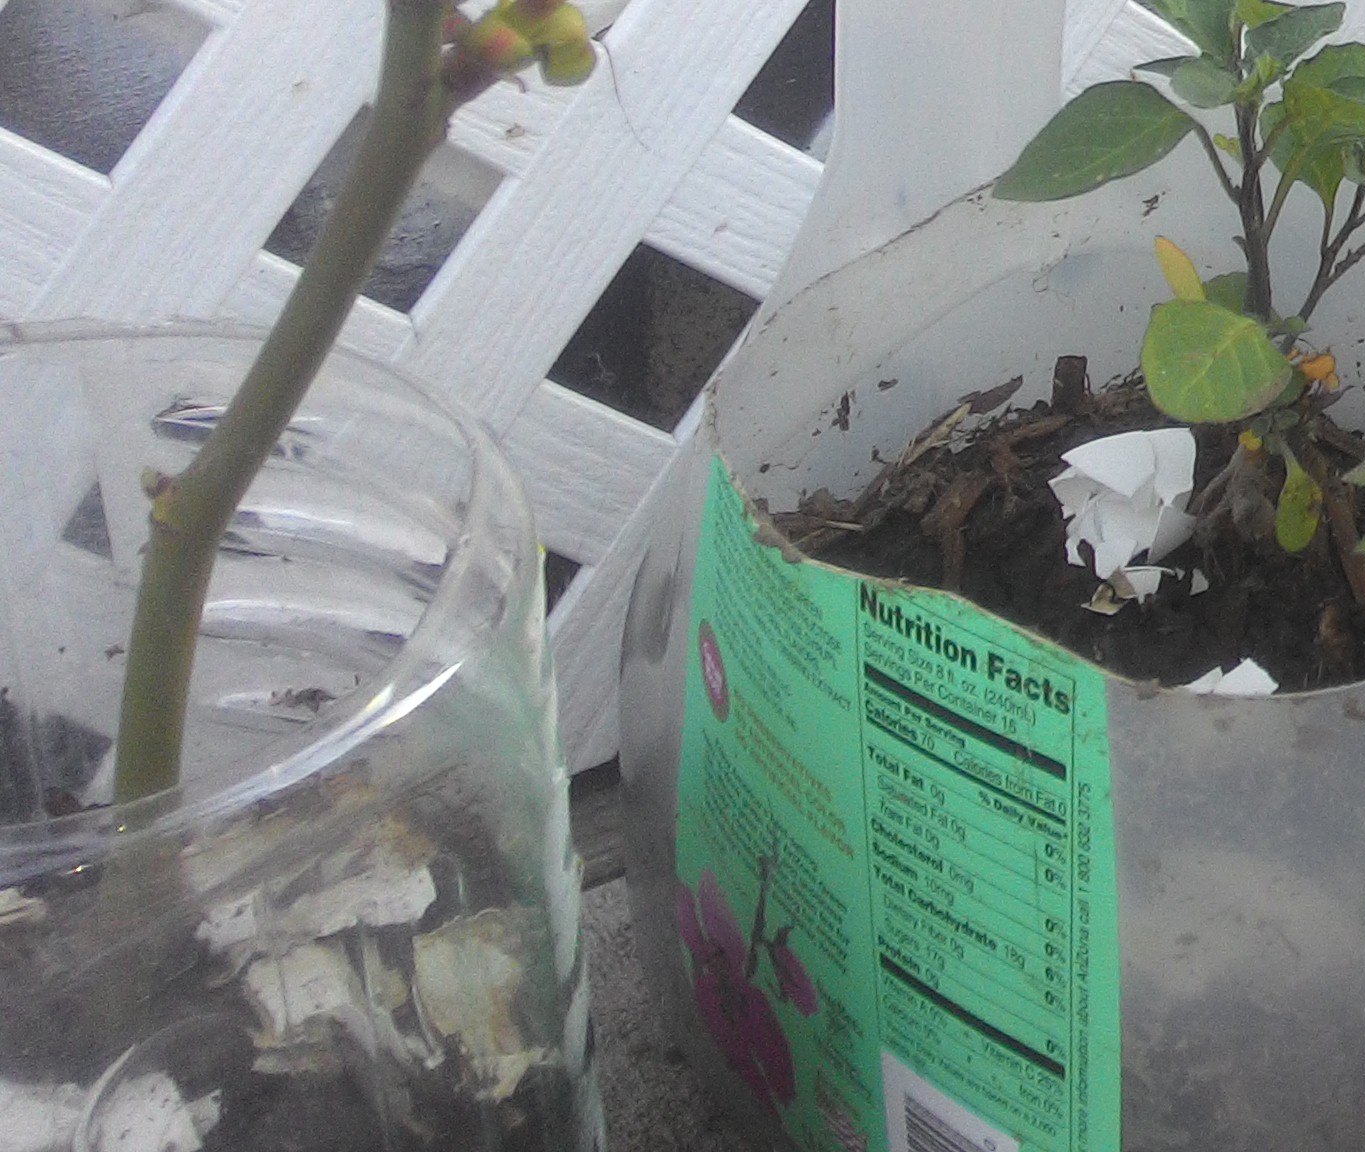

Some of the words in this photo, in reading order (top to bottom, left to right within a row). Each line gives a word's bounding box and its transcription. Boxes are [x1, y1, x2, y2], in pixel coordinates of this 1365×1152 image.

[859, 583, 976, 670] Nutrition
[987, 651, 1069, 714] Facts
[862, 621, 905, 662] Serving
[907, 647, 933, 673] Size
[935, 663, 944, 679] 8
[863, 641, 911, 681] Servings
[913, 670, 935, 693] Per
[937, 683, 996, 723] Container
[1001, 715, 1016, 734] 16
[863, 681, 901, 711] Amount
[903, 705, 922, 723] Per
[924, 716, 965, 748] Serving
[864, 698, 917, 741] Calories
[920, 731, 935, 751] 70
[953, 750, 1002, 786] Calories
[1004, 774, 1033, 800] from
[1035, 789, 1055, 812] Fat
[1057, 801, 1066, 817] 0
[866, 744, 899, 775] Total
[902, 767, 923, 790] Fat
[929, 783, 945, 806] 0g
[1044, 842, 1067, 866] 0%
[904, 815, 923, 836] Fat
[924, 827, 940, 850] 0g
[930, 806, 948, 828] Fat
[950, 818, 966, 841] 0g
[1044, 868, 1067, 890] 0%
[977, 789, 990, 806] %
[993, 798, 1024, 823] Daily
[870, 818, 943, 872] Cholesterol
[949, 865, 974, 894] 0mg
[1044, 917, 1067, 940] 0%
[871, 841, 918, 880] Sodium
[924, 875, 954, 907] 10mg
[1044, 942, 1067, 964] 0%
[872, 864, 905, 895] Total
[907, 888, 996, 950] Carbohydrate
[1077, 928, 1090, 981] Arizona
[877, 934, 920, 974] Protein
[1044, 1038, 1067, 1063] 0%
[1044, 989, 1067, 1012] 0%
